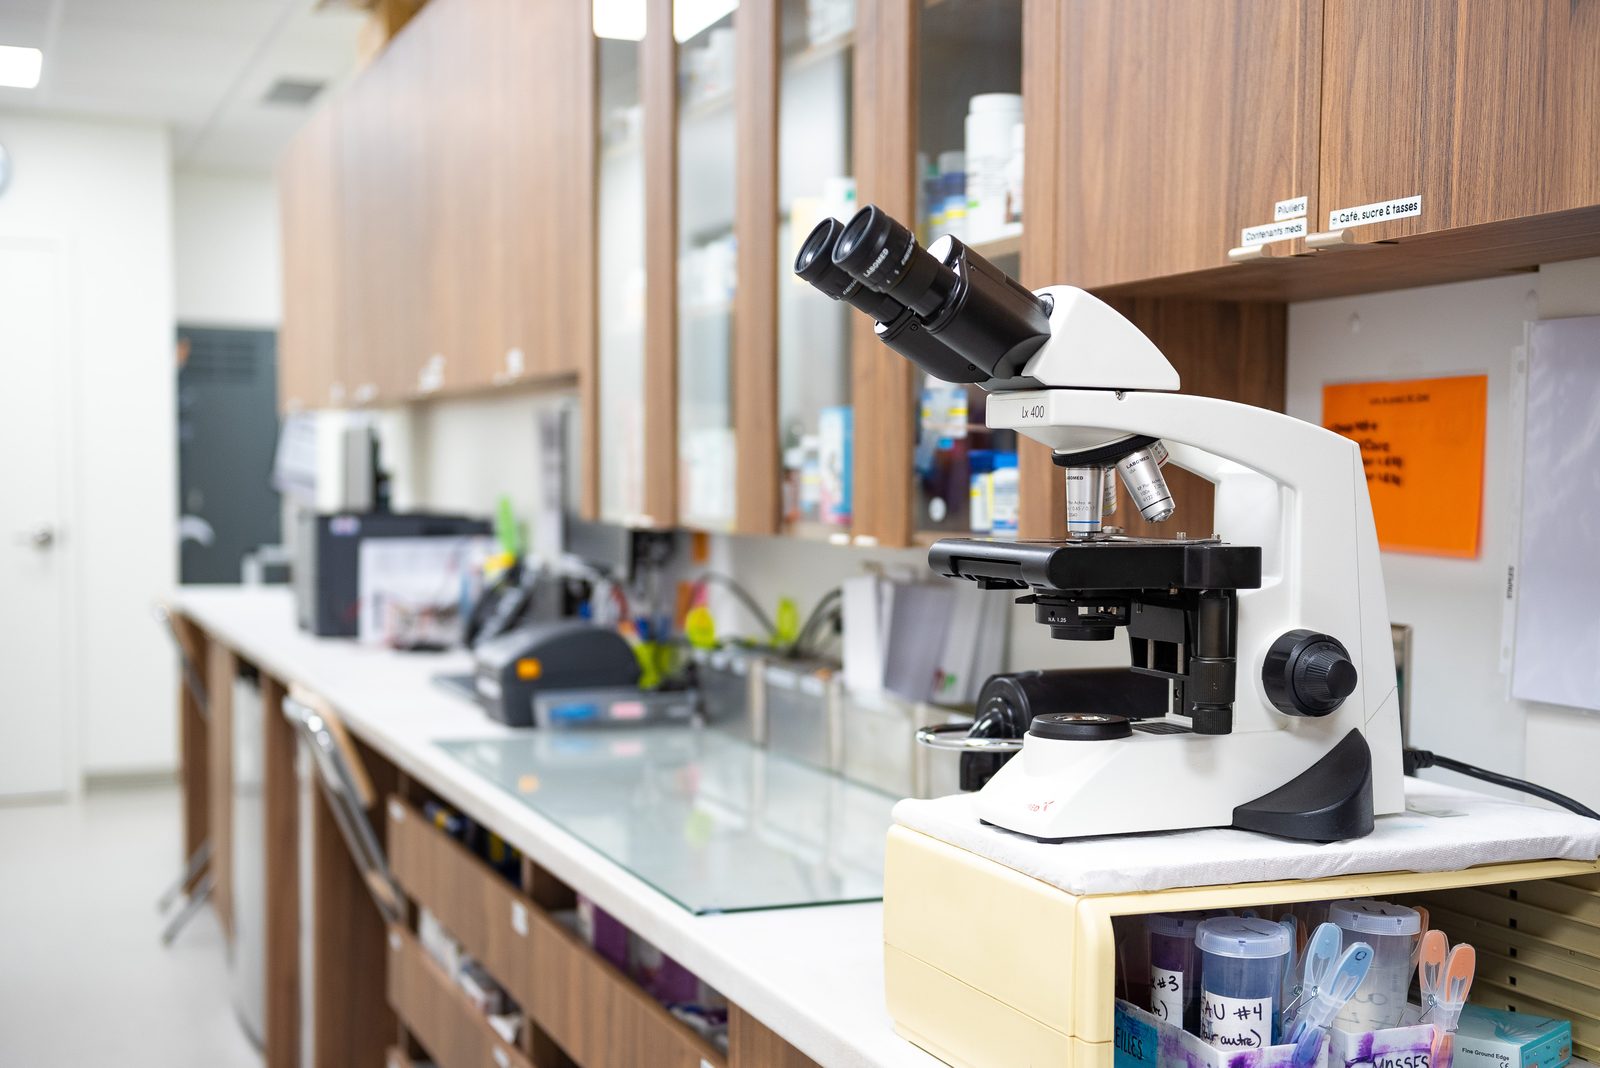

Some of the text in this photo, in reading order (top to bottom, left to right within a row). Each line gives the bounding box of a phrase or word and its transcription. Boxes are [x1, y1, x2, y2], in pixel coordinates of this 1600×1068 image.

[1361, 207, 1384, 219] sucre
[1392, 201, 1418, 214] tasses
[863, 247, 889, 278] LABOMED
[1021, 404, 1045, 419] Lx 400
[1233, 1003, 1262, 1021] #4
[1115, 1026, 1145, 1060] EILLES
[1474, 1049, 1494, 1059] Ground
[1495, 1053, 1510, 1061] Edge
